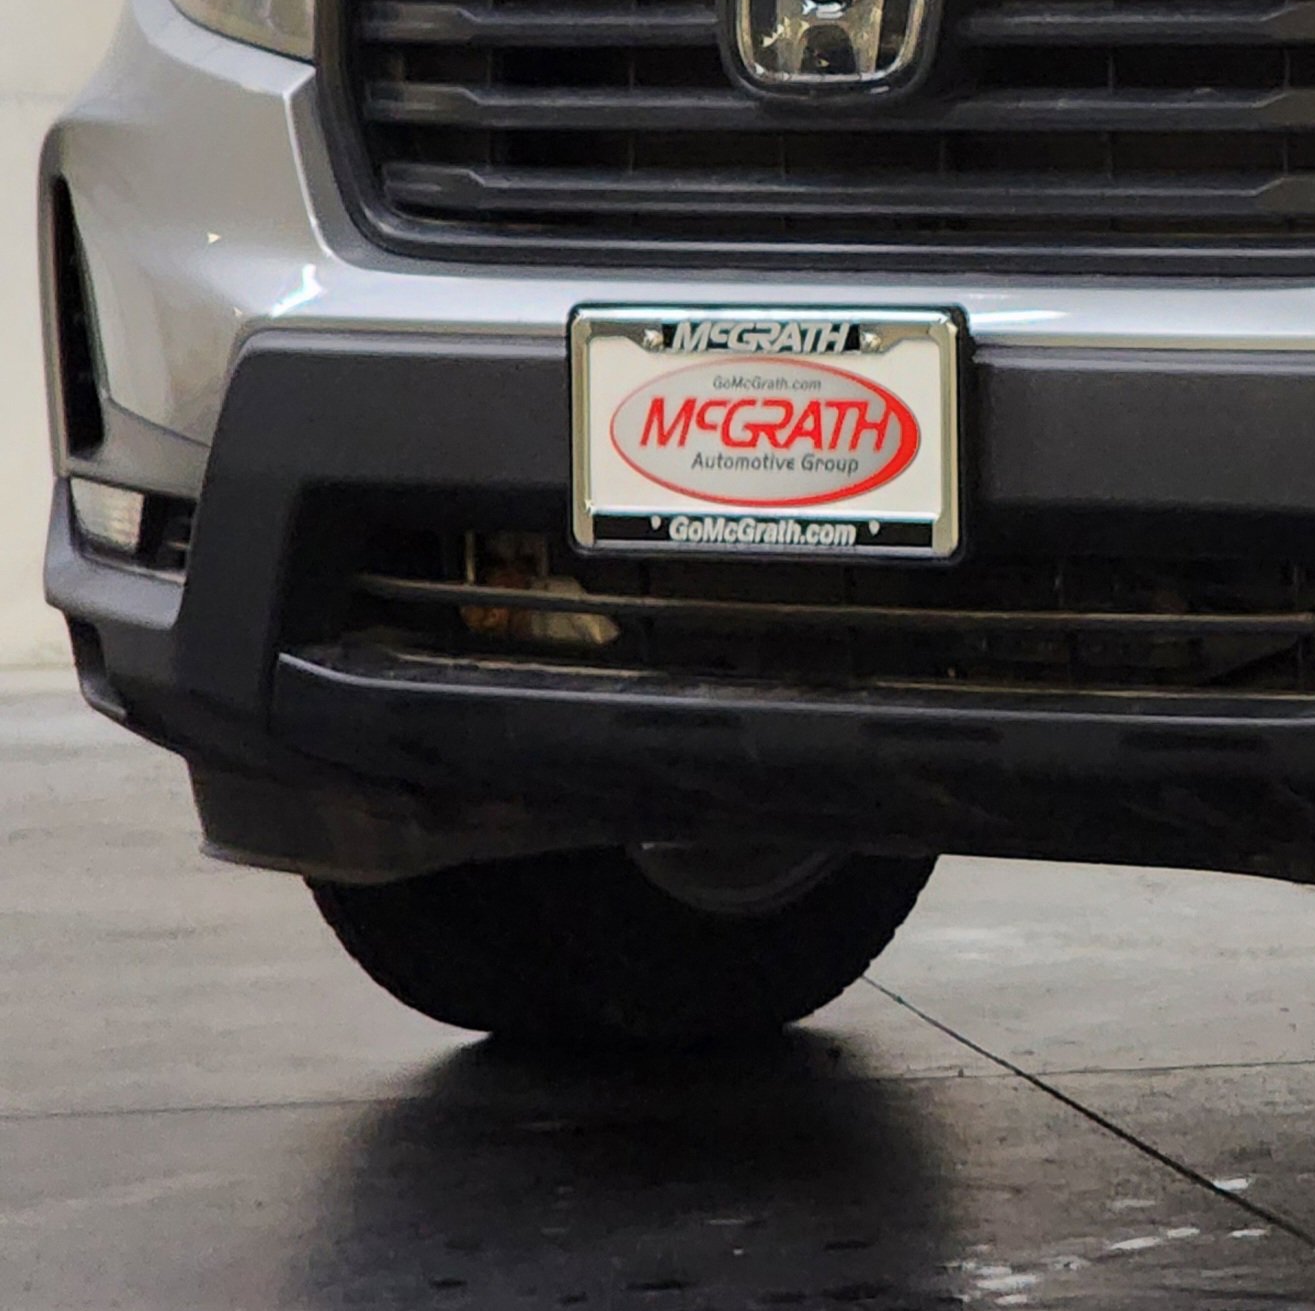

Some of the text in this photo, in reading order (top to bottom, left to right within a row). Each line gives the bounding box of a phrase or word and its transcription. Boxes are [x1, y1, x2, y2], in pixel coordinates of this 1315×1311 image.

[672, 322, 850, 353] McGRATH
[712, 375, 822, 392] GoMcGrath.com
[640, 397, 891, 451] McGRATH
[691, 453, 859, 475] Automotive Group
[668, 515, 857, 547] GoMcGrath.com
